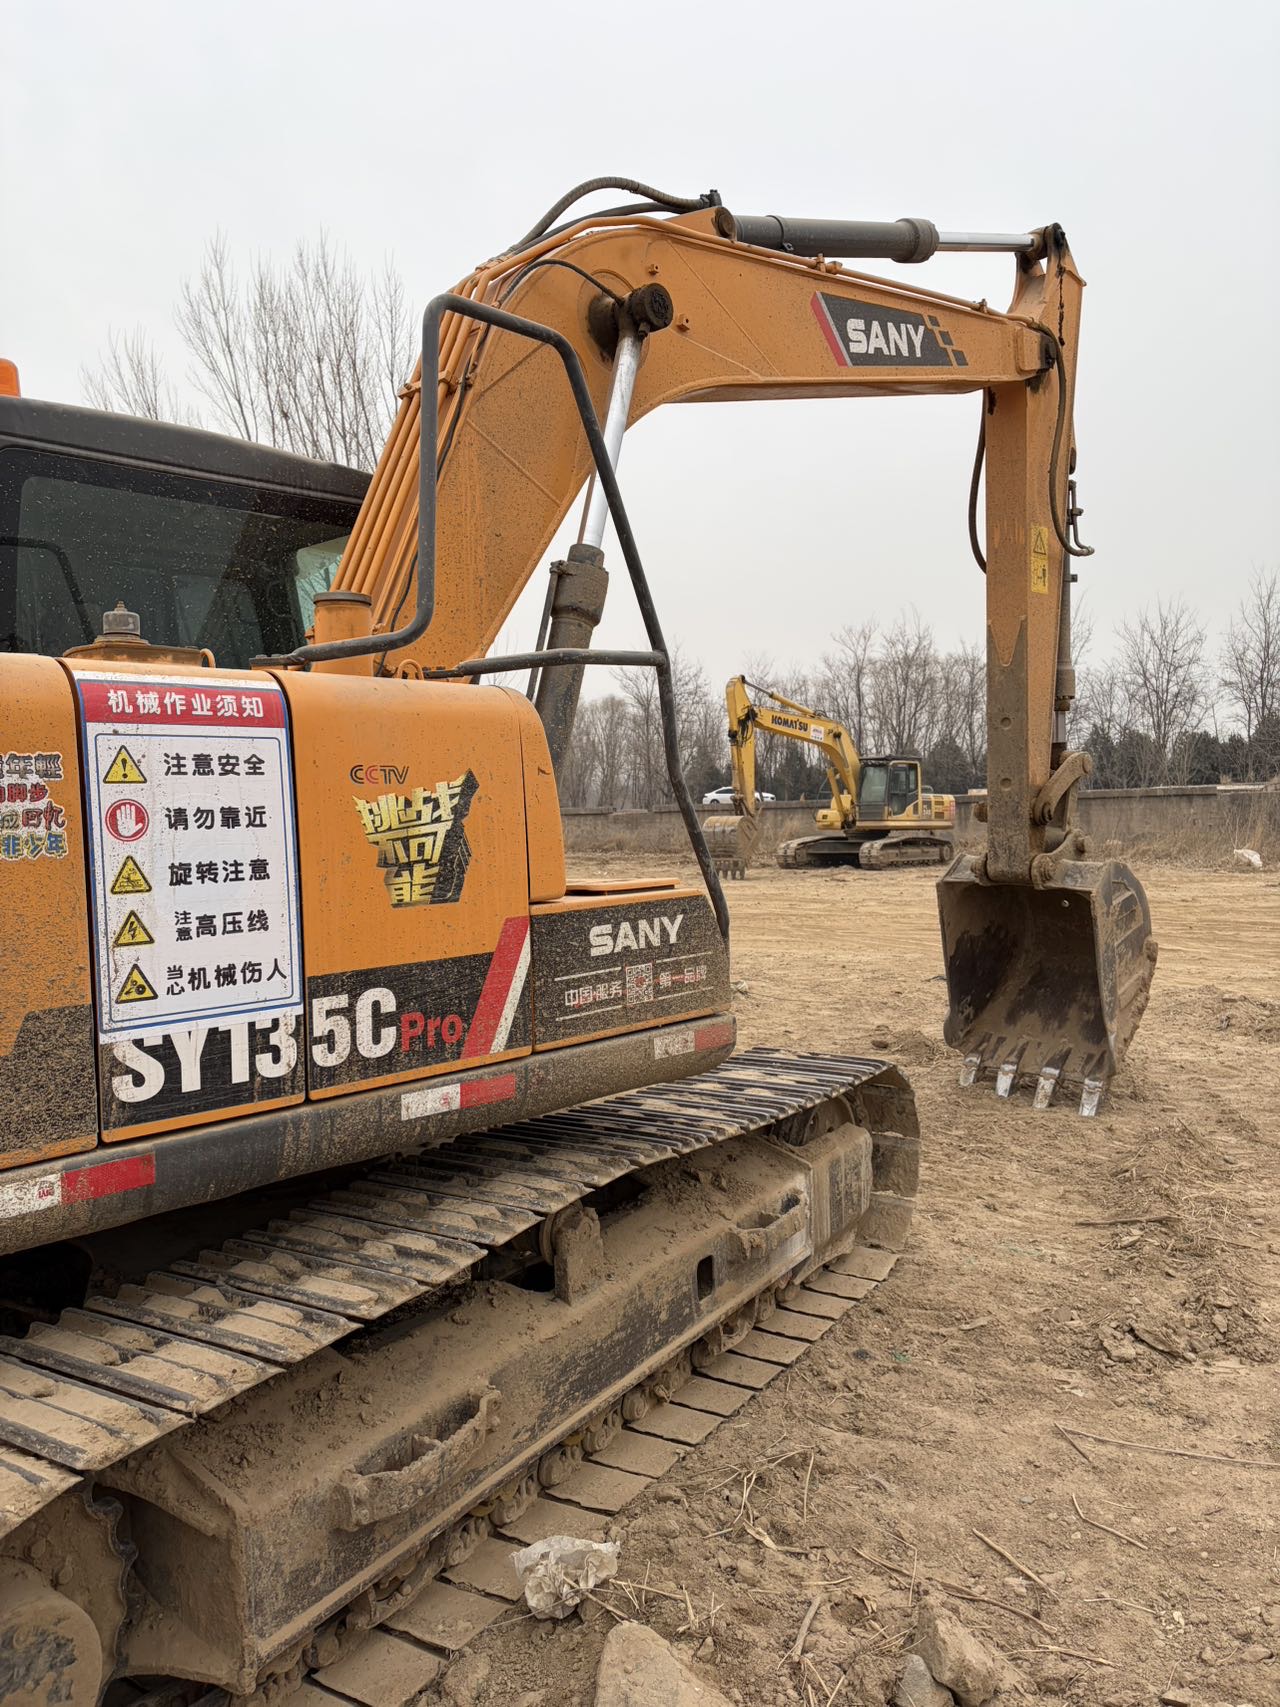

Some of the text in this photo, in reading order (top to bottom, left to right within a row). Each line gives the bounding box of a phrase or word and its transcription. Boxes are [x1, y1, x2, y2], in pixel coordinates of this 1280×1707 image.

[846, 318, 925, 358] SANY
[107, 689, 265, 718] 机械作业须知
[771, 714, 809, 732] KOMATSU
[0, 753, 62, 779] 年輕
[163, 752, 266, 777] 注意安全
[350, 764, 410, 785] CCTV
[164, 805, 268, 831] 请勿靠近
[168, 859, 271, 887] 旋转注意
[589, 914, 684, 956] SANY
[565, 980, 622, 1007] 中国服务
[401, 1011, 464, 1052] Pro
